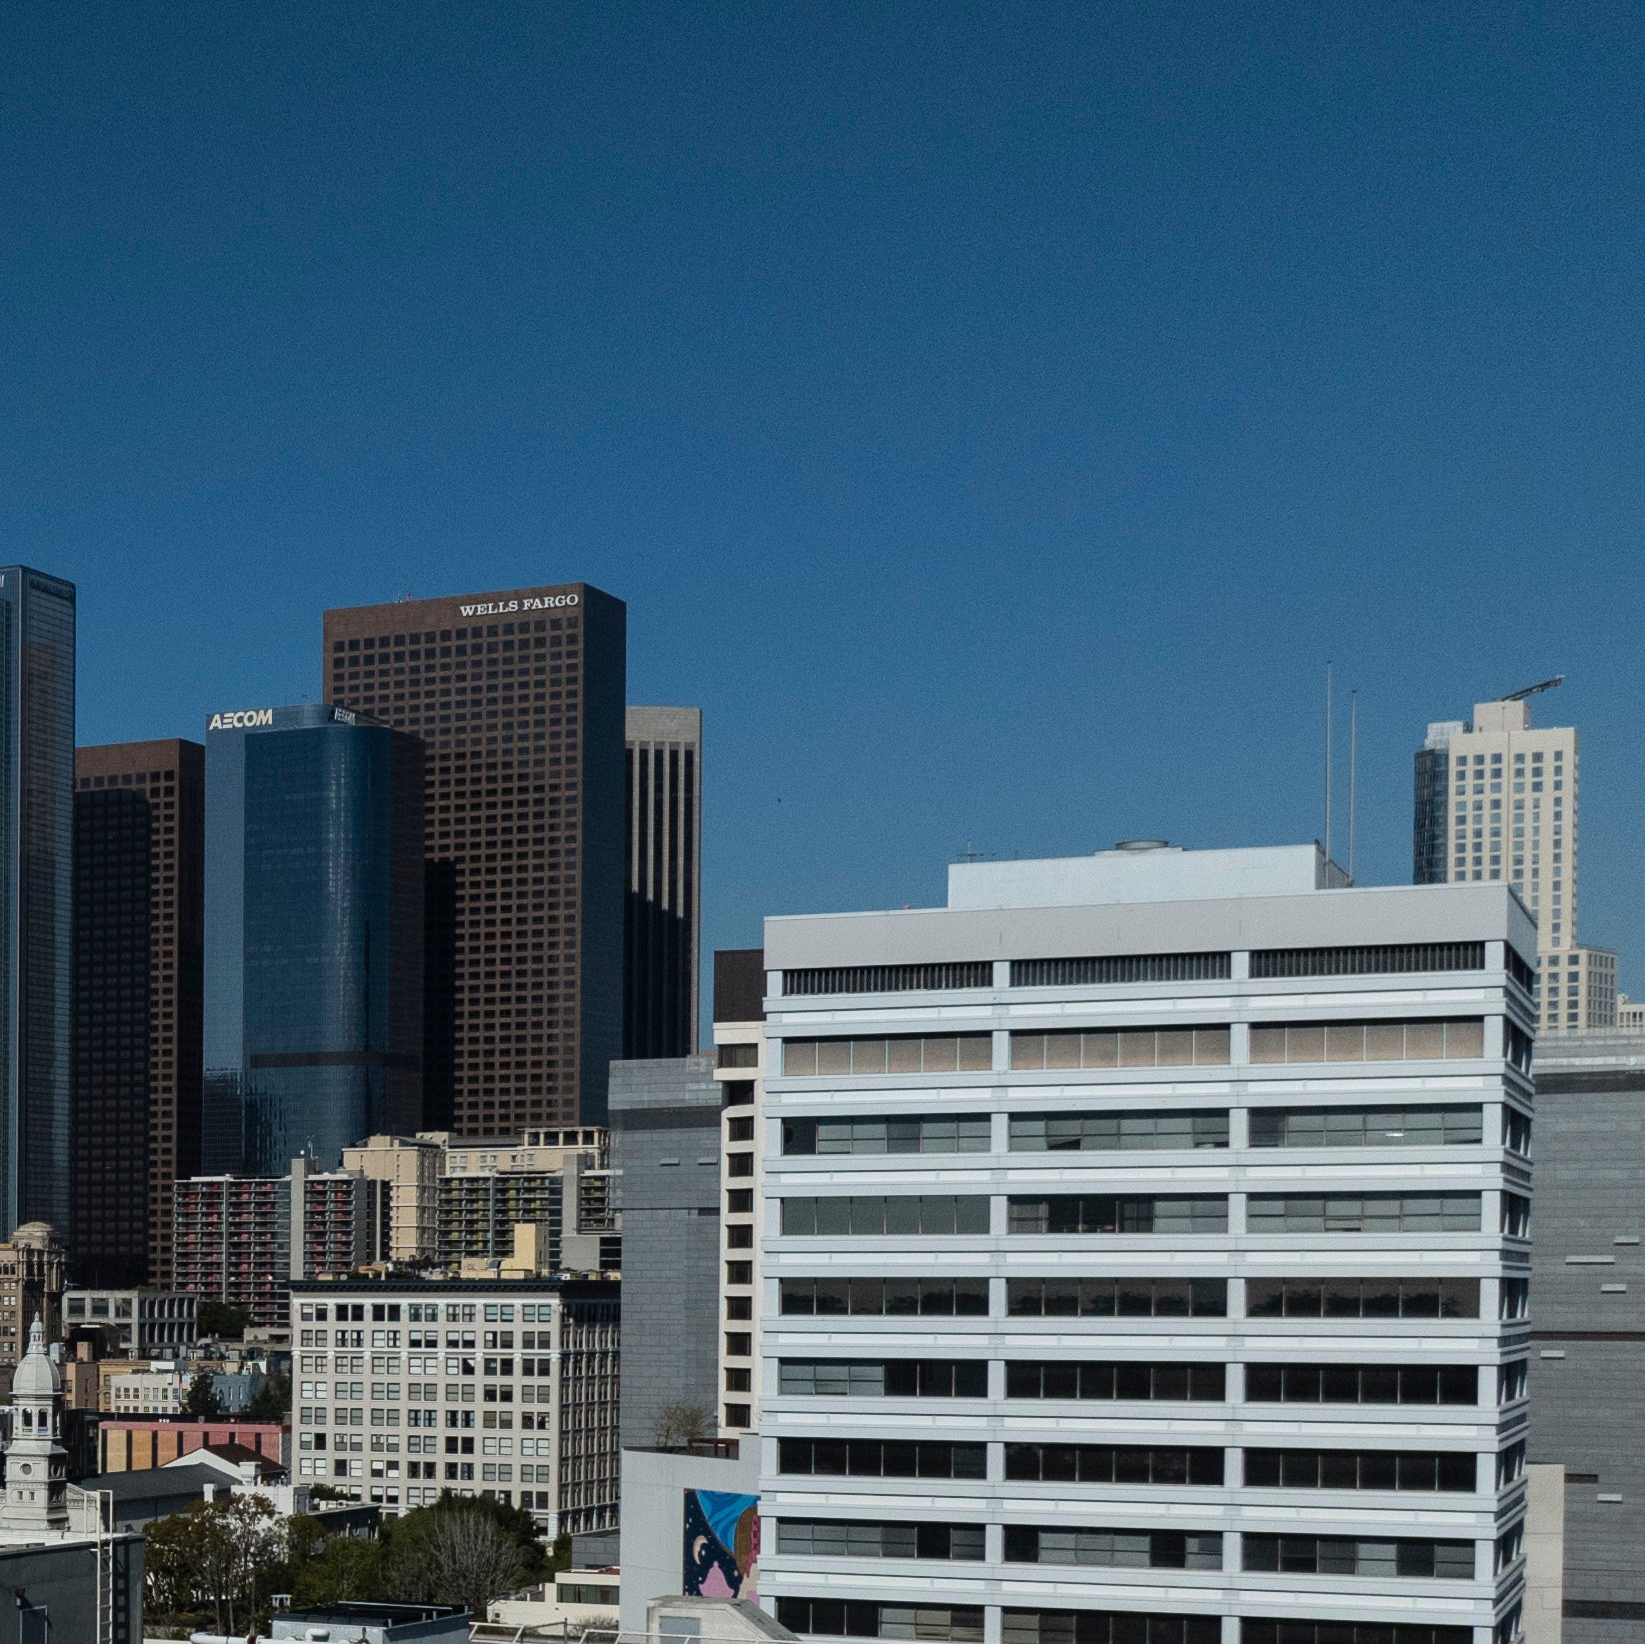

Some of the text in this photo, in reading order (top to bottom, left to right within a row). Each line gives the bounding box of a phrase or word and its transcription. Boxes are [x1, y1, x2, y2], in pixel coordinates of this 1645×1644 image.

[459, 594, 579, 617] WELLS FARGO
[208, 708, 273, 731] AECOM
